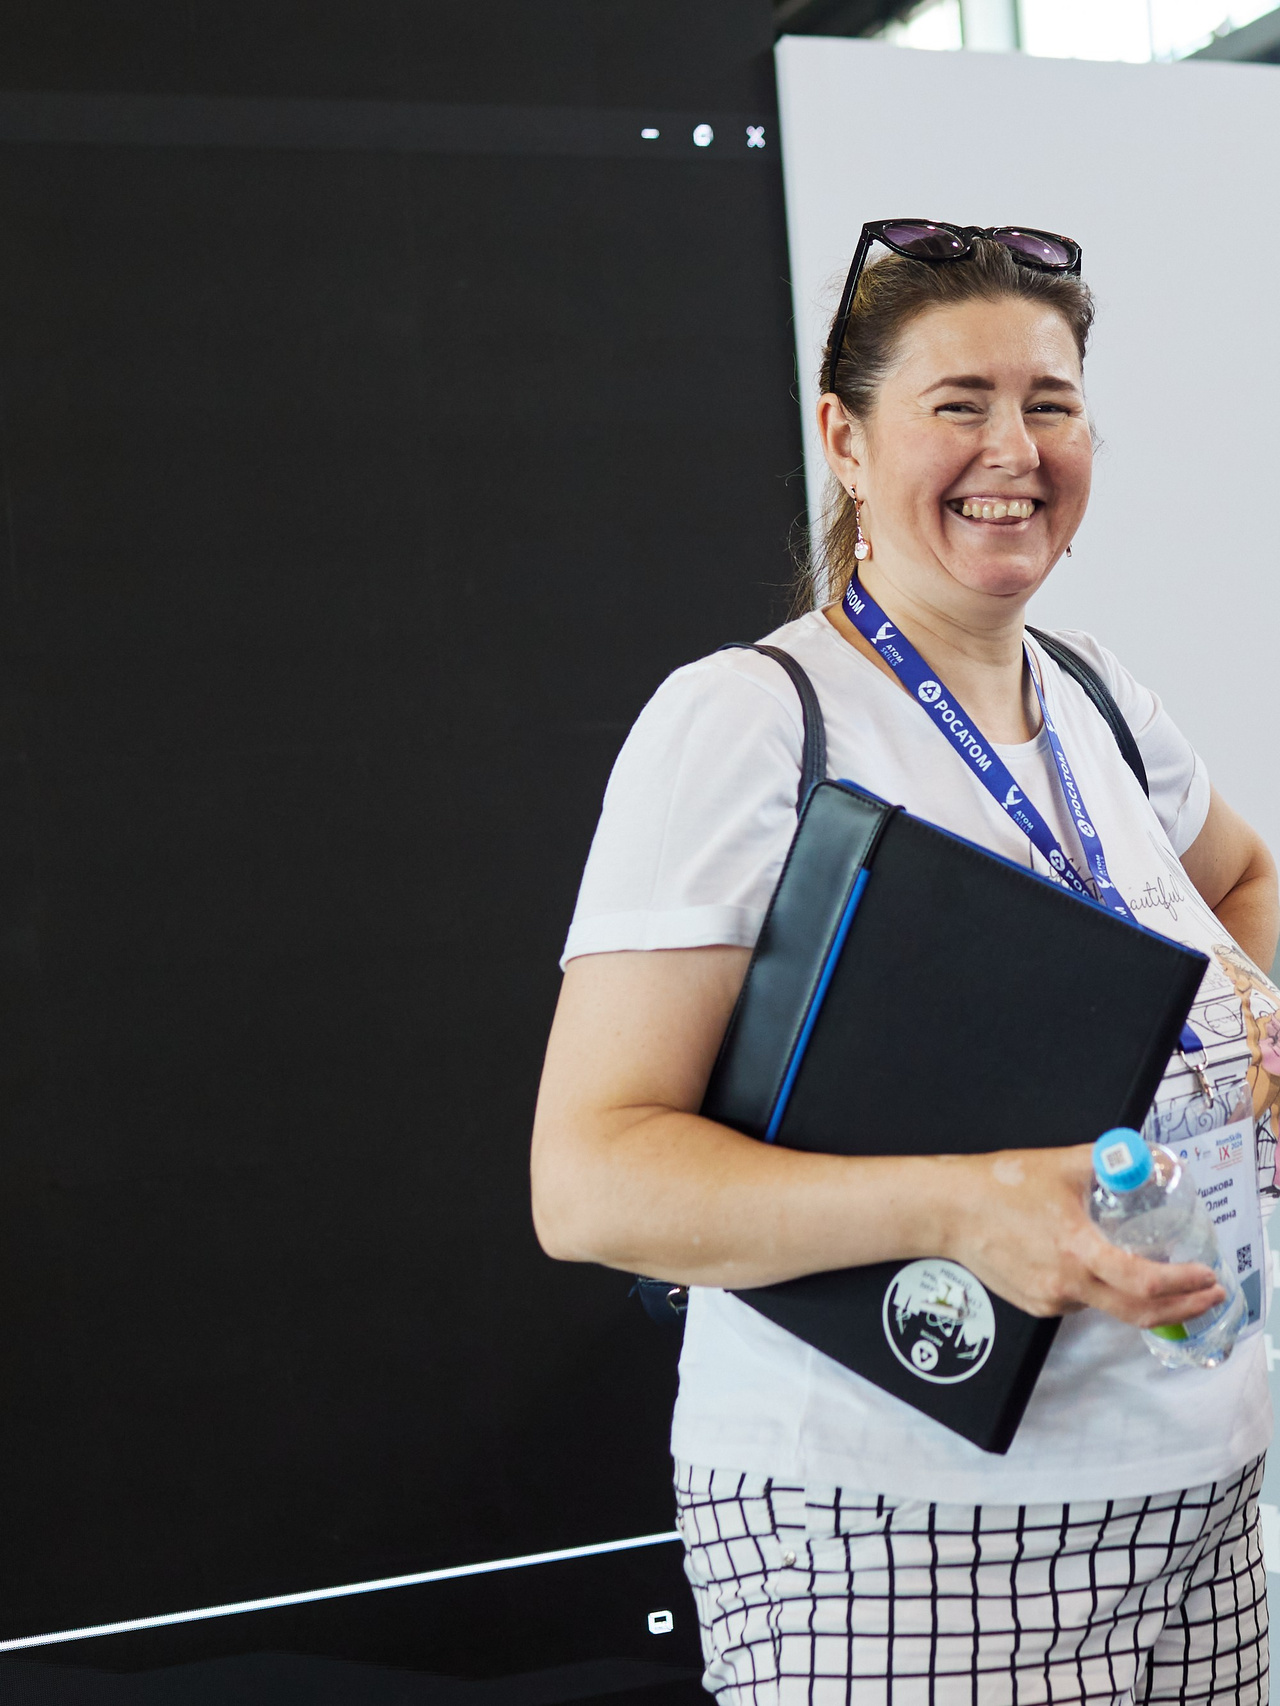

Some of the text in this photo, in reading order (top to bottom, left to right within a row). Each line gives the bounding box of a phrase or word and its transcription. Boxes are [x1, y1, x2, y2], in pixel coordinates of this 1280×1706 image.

[885, 643, 904, 664] ATOM
[934, 699, 993, 772] РОСАТОМ
[1056, 750, 1086, 819] РОСАТОМ
[1130, 874, 1185, 921] autiful
